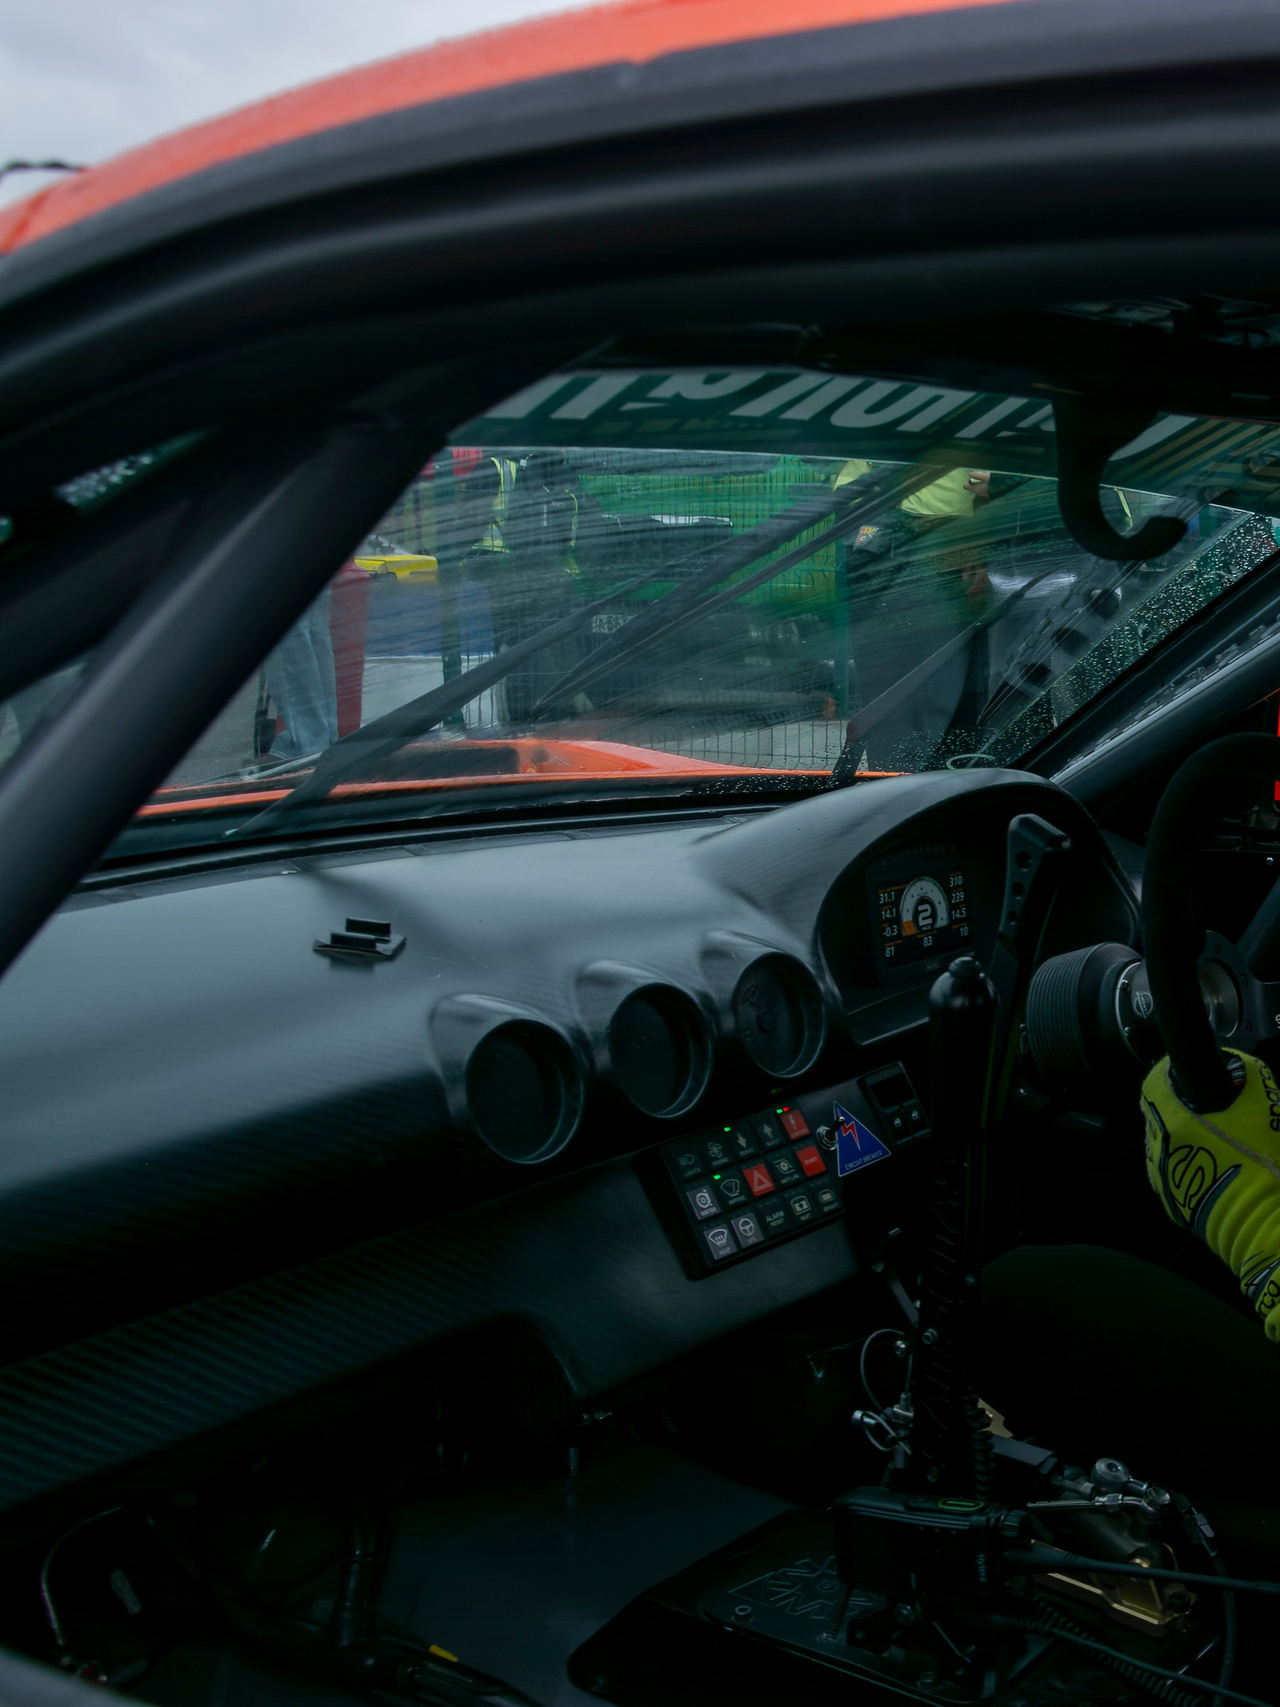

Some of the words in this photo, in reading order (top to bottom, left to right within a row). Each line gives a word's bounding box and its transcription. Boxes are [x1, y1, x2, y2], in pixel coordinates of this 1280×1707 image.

[949, 876, 963, 887] 310
[879, 891, 895, 904] 31.1
[951, 892, 964, 903] 239
[881, 908, 896, 919] 14.1
[918, 904, 933, 927] 2
[951, 908, 966, 919] 14.5
[960, 927, 968, 936] 10
[923, 936, 932, 946] 83
[885, 947, 895, 957] 81
[844, 1157, 864, 1171] CIRCUIT
[862, 1149, 883, 1163] BREAKER
[699, 1205, 717, 1217] WATER
[765, 1210, 785, 1223] ALARM
[799, 1212, 812, 1221] NEXT
[770, 1217, 785, 1227] RESET
[718, 1246, 732, 1256] HEAT
